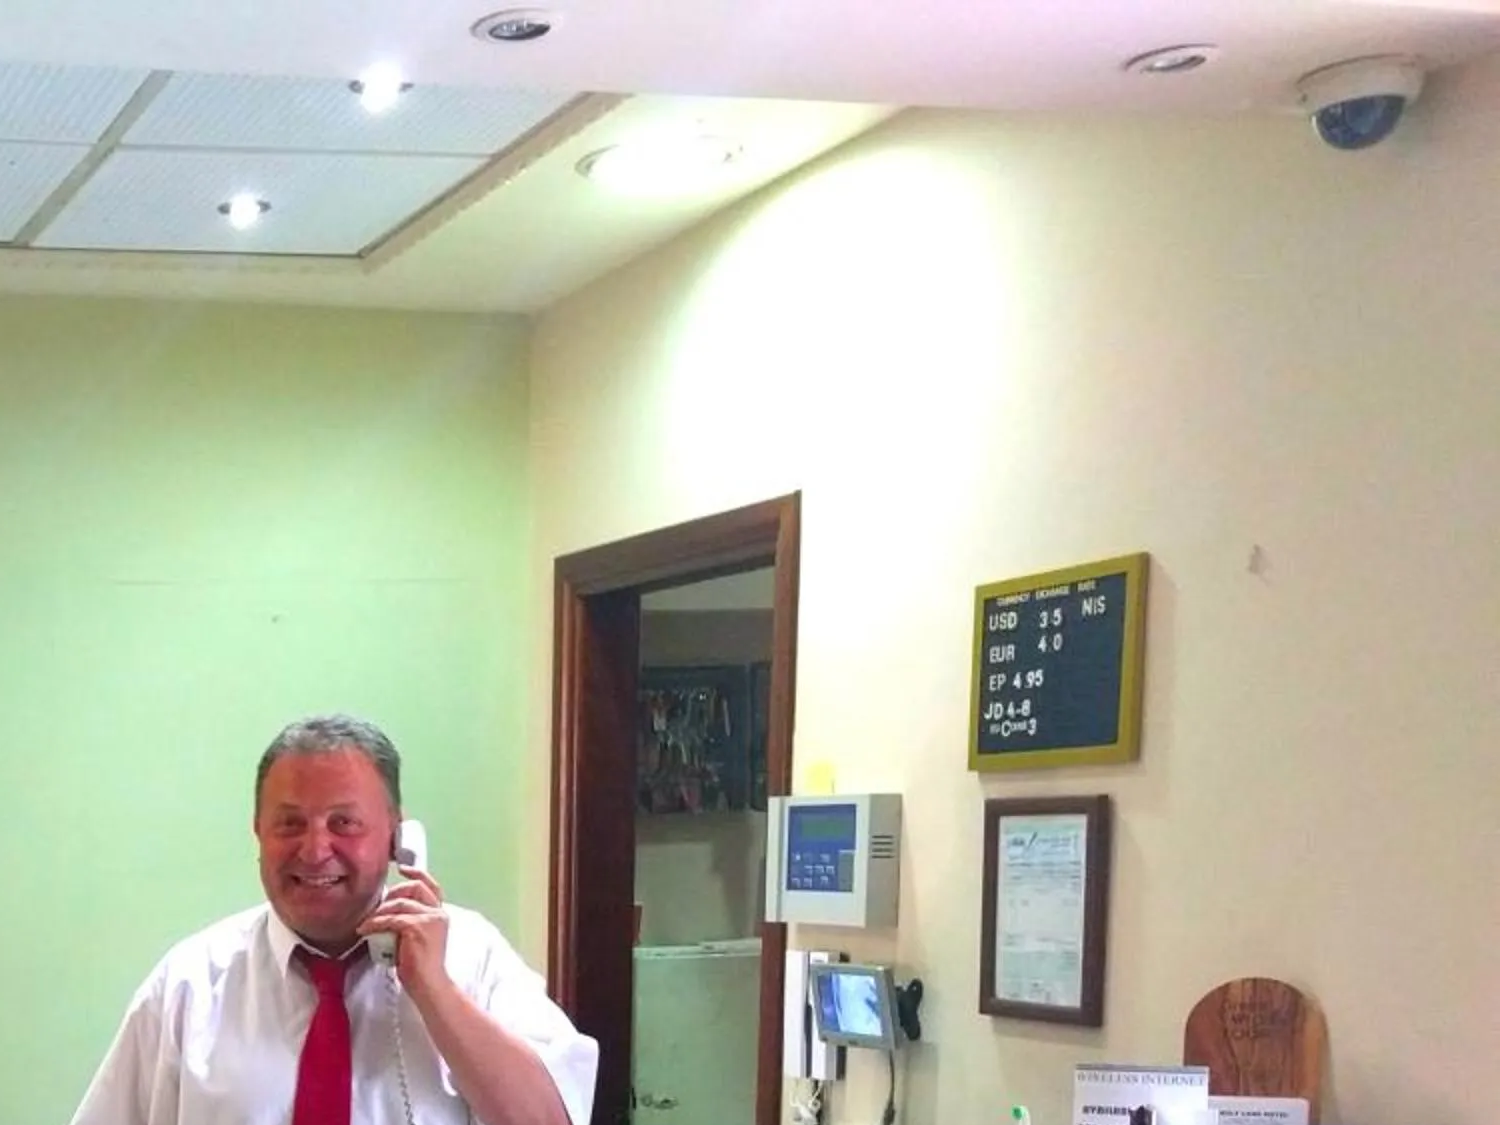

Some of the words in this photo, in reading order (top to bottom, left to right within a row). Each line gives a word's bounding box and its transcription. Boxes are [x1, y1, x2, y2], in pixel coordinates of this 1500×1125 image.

[989, 611, 1018, 631] USD
[1081, 595, 1106, 616] NIS
[989, 644, 1015, 664] EUR
[989, 673, 1007, 691] EP
[984, 702, 1004, 720] JD
[1141, 1075, 1205, 1087] INTERNET
